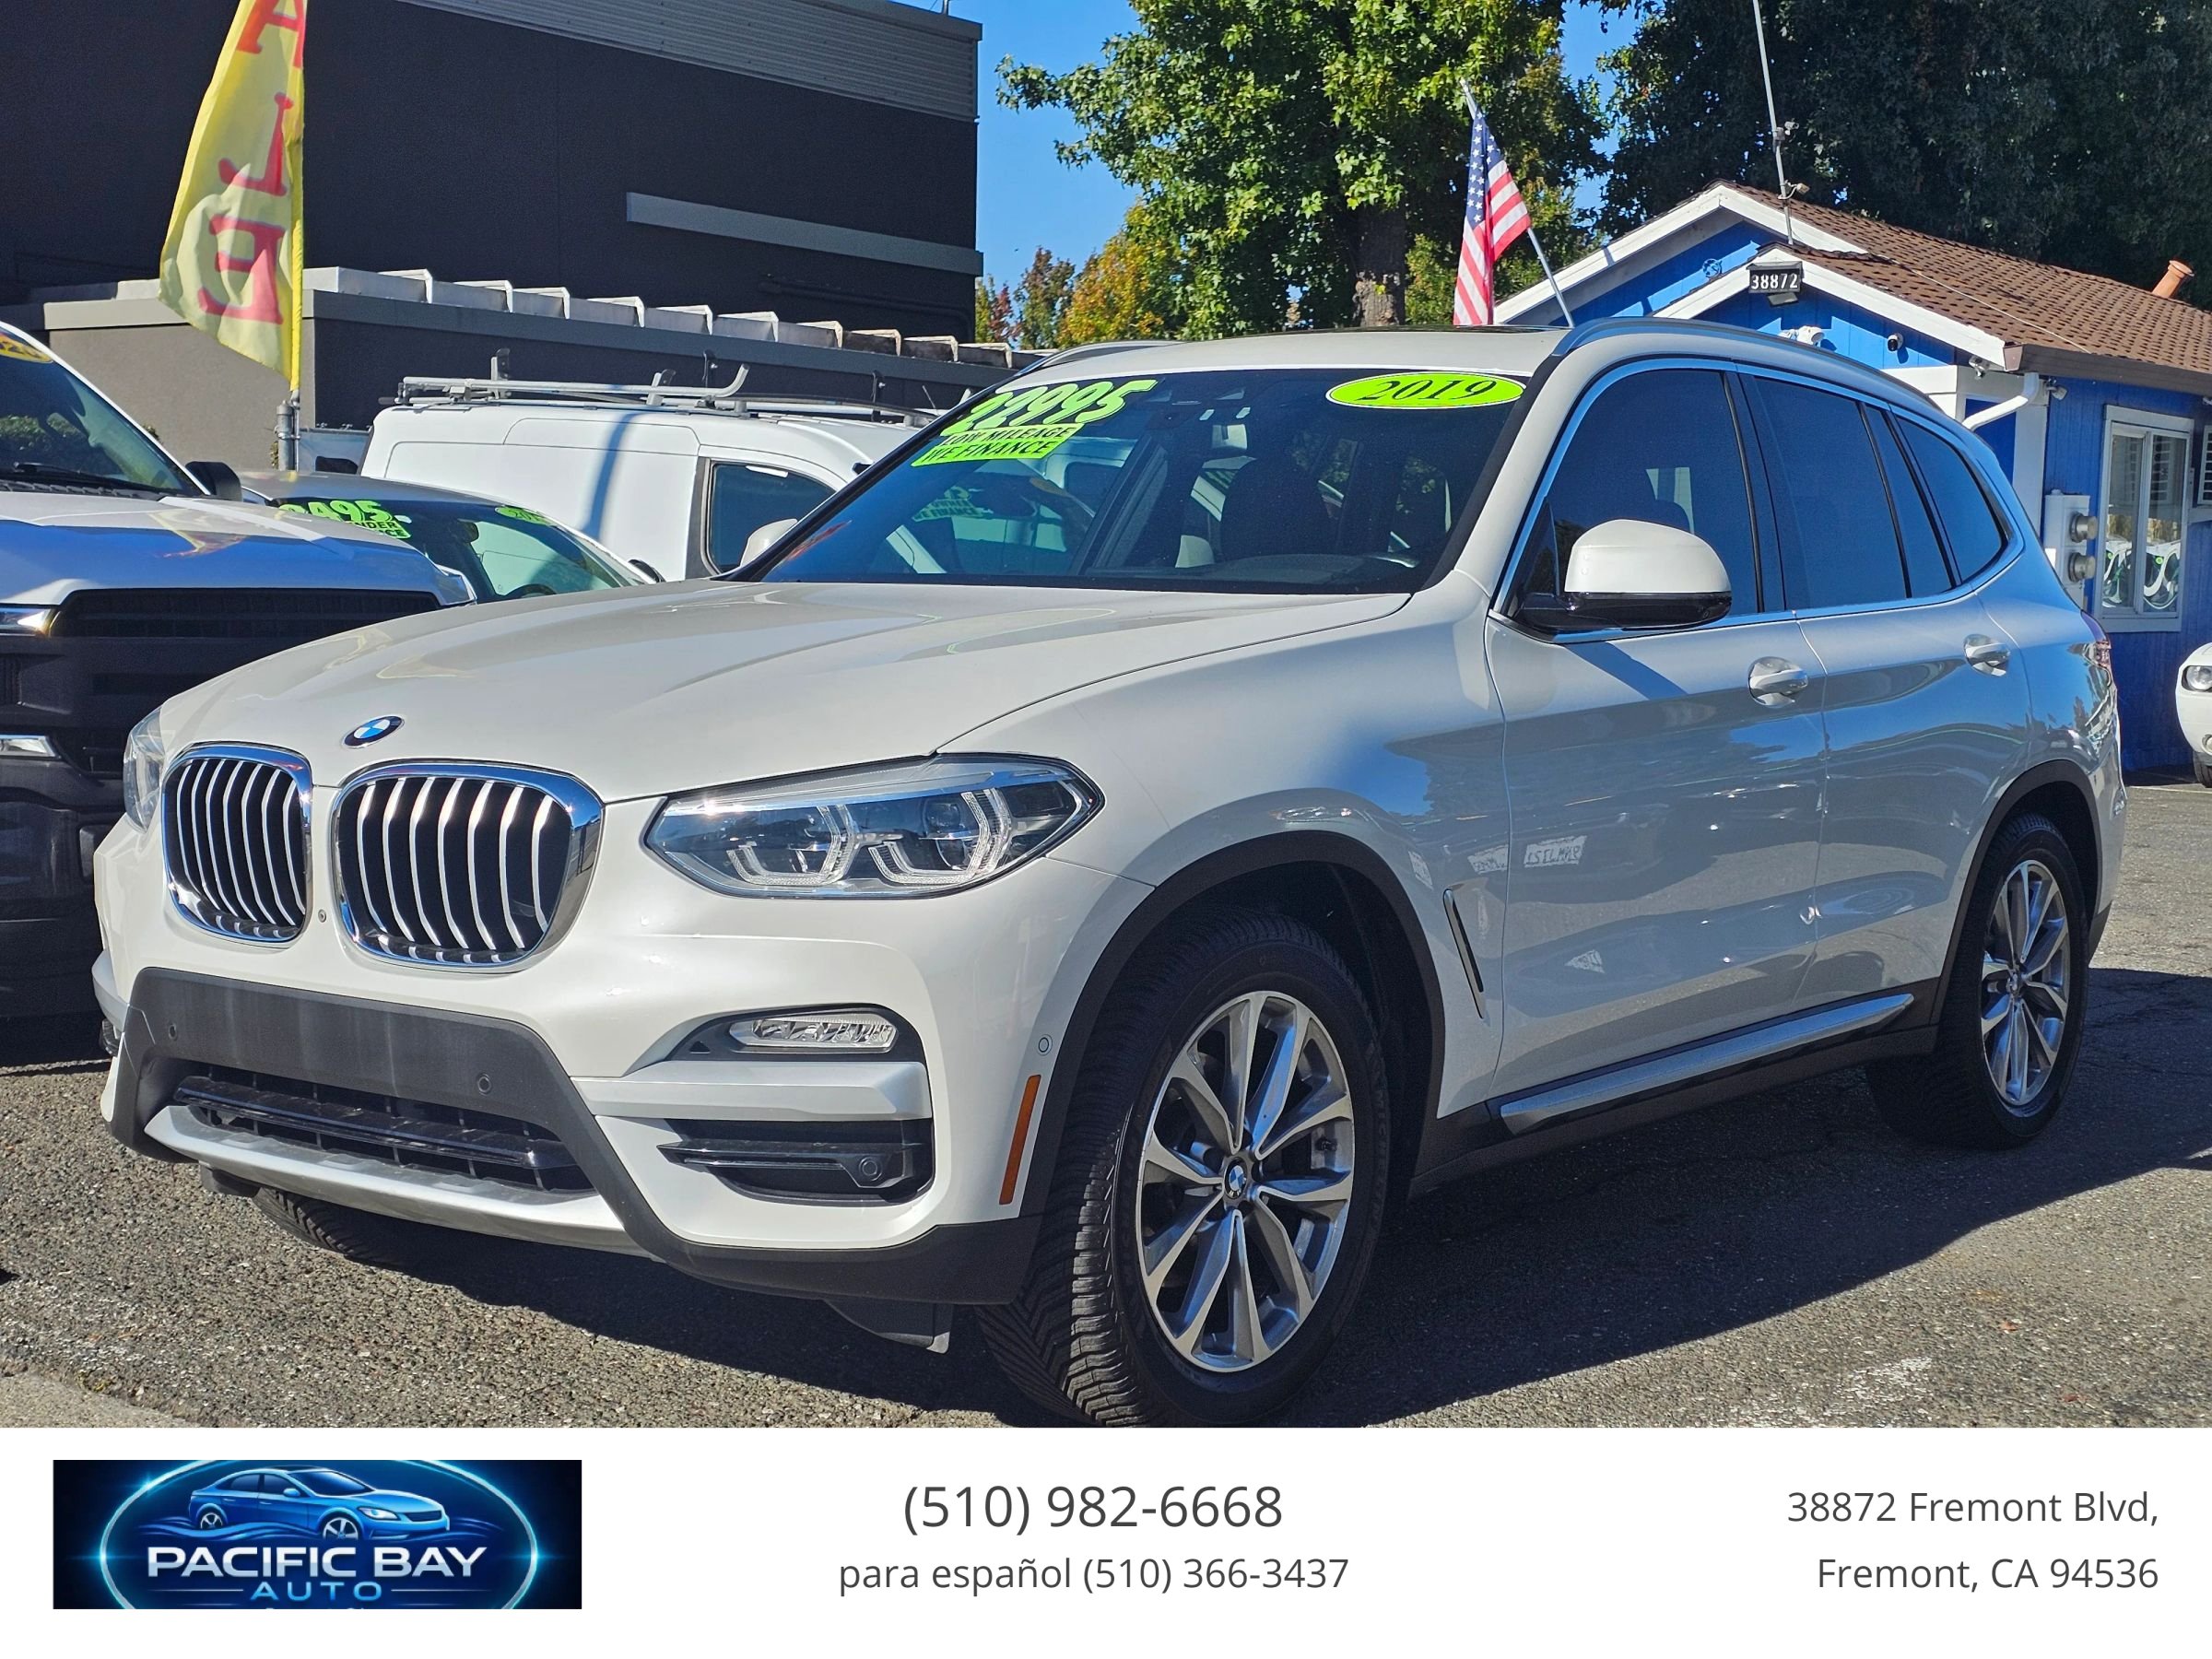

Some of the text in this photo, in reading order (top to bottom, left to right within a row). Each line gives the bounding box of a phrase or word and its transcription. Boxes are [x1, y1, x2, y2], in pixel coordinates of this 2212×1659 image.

[1751, 273, 1798, 290] 38872
[1354, 379, 1498, 401] 2019
[940, 379, 1159, 436] 22995
[943, 427, 1076, 445] LOW MILEAGE
[924, 441, 1057, 463] WE FINANCE
